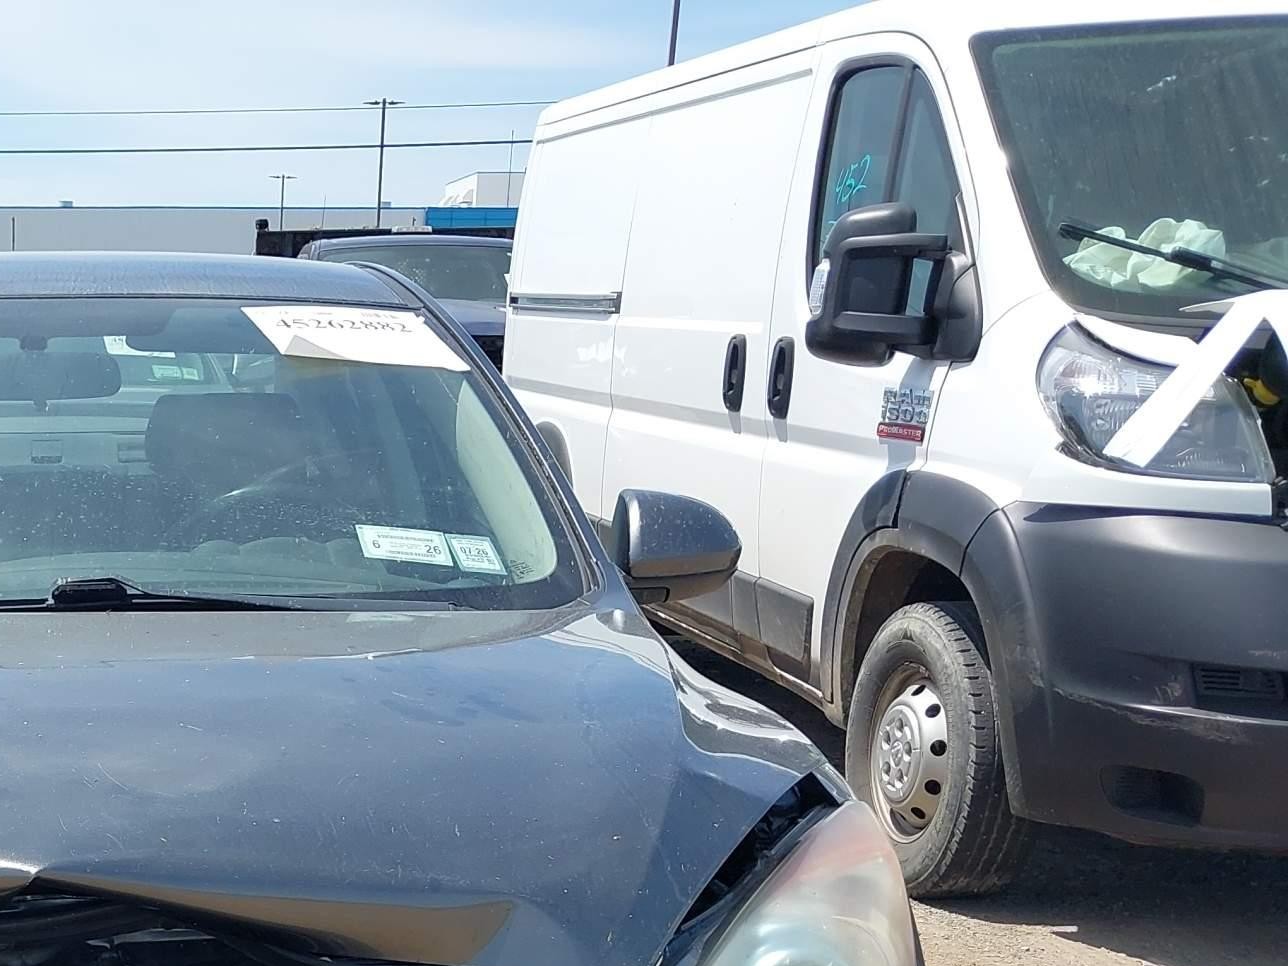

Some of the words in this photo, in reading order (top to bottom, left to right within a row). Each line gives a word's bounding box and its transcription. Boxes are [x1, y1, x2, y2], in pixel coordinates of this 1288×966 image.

[835, 153, 871, 205] 452
[275, 318, 413, 333] 45262882
[372, 539, 381, 549] 6
[424, 544, 442, 555] 26
